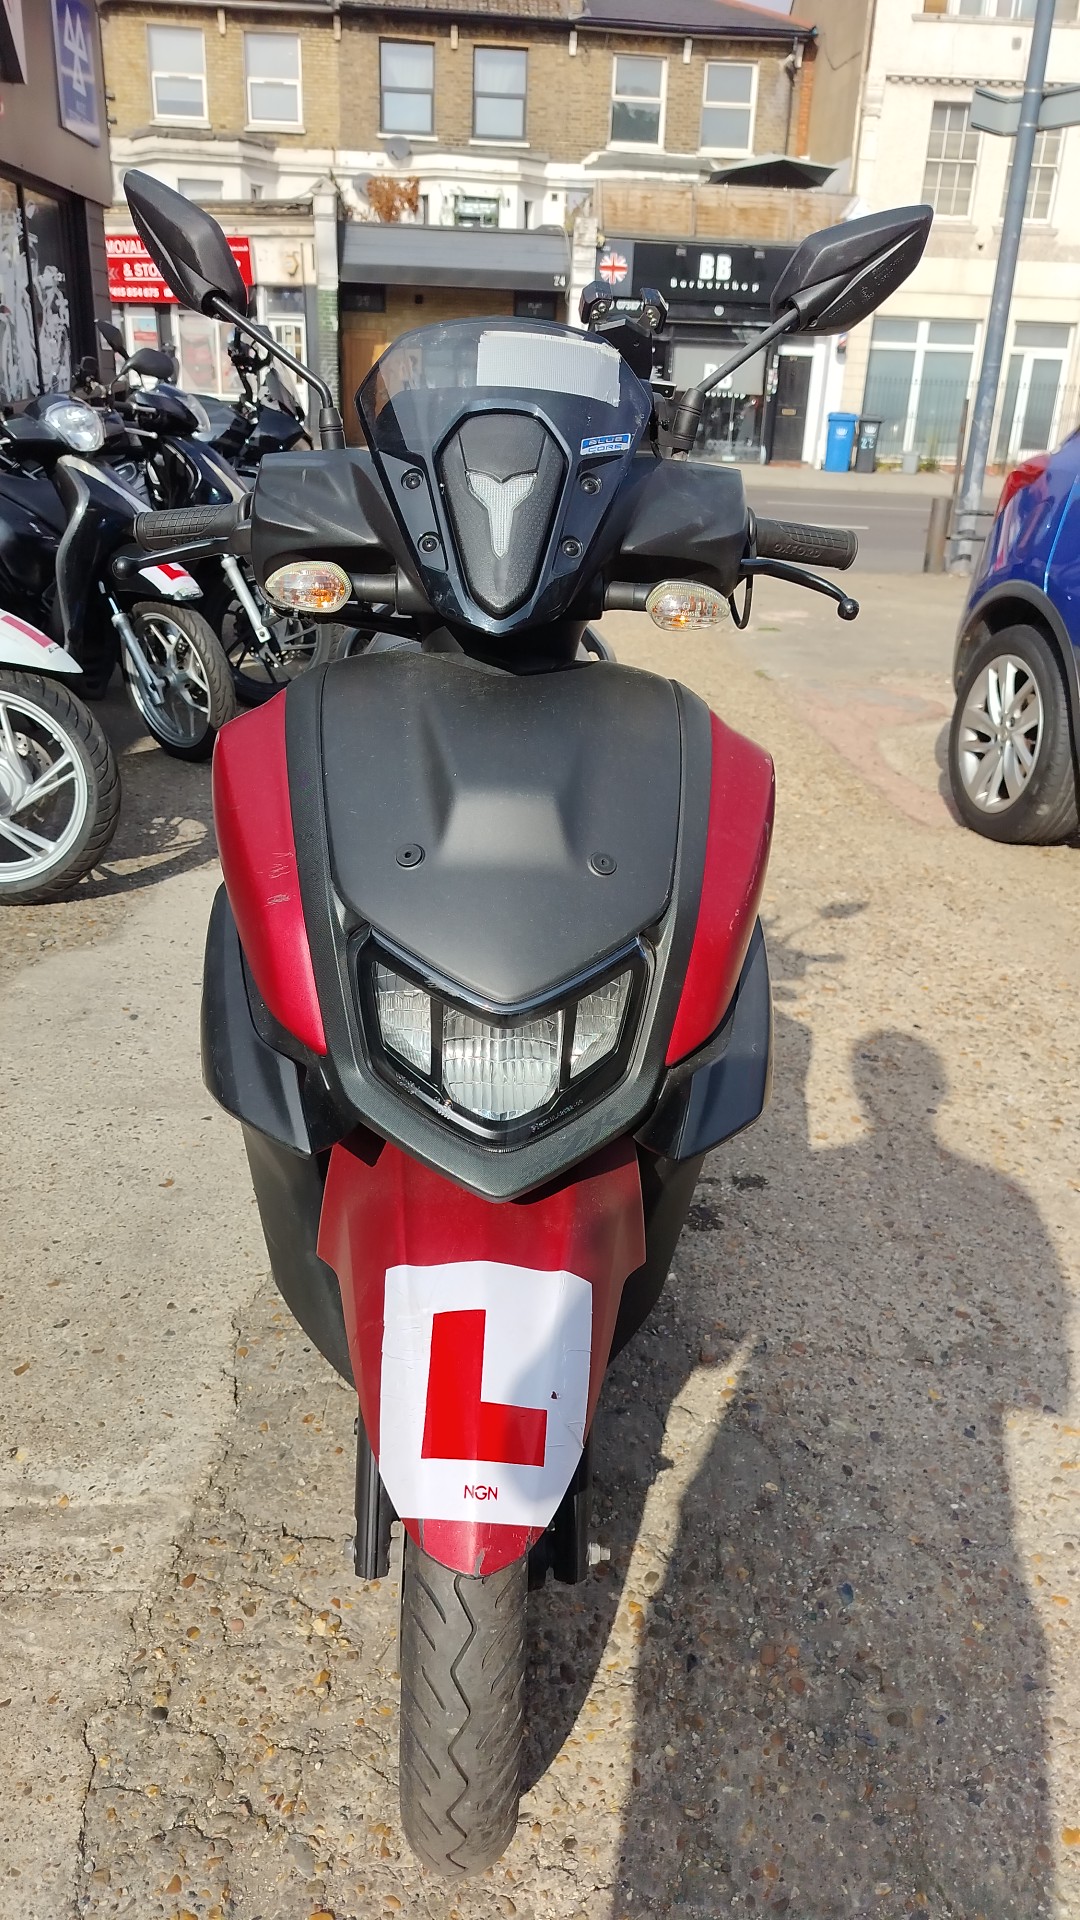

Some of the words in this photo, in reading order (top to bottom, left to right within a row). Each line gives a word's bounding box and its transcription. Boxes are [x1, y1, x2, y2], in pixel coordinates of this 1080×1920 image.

[105, 238, 148, 254] MOVAL
[122, 262, 133, 277] &
[133, 263, 162, 277] STO
[699, 252, 732, 280] BB
[588, 436, 623, 446] BLUE
[588, 443, 623, 453] CORE
[420, 1309, 547, 1467] L
[463, 1484, 498, 1501] NGN
